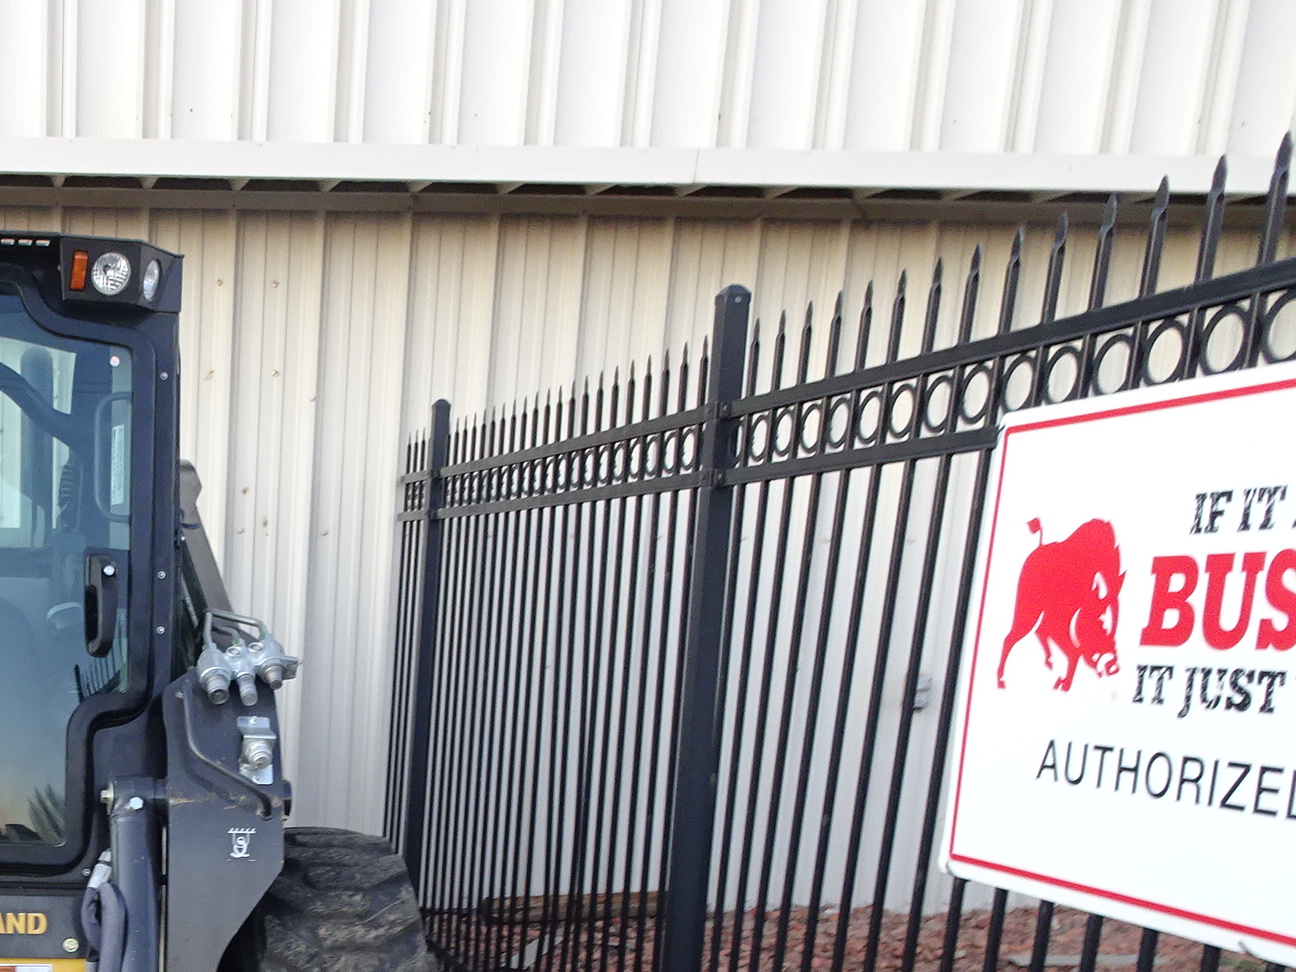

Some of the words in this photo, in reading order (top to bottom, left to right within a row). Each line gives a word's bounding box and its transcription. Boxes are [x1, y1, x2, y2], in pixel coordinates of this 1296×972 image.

[1189, 490, 1234, 536] IF
[1236, 484, 1288, 533] IT
[1132, 664, 1175, 706] IT
[1177, 667, 1288, 719] JUST
